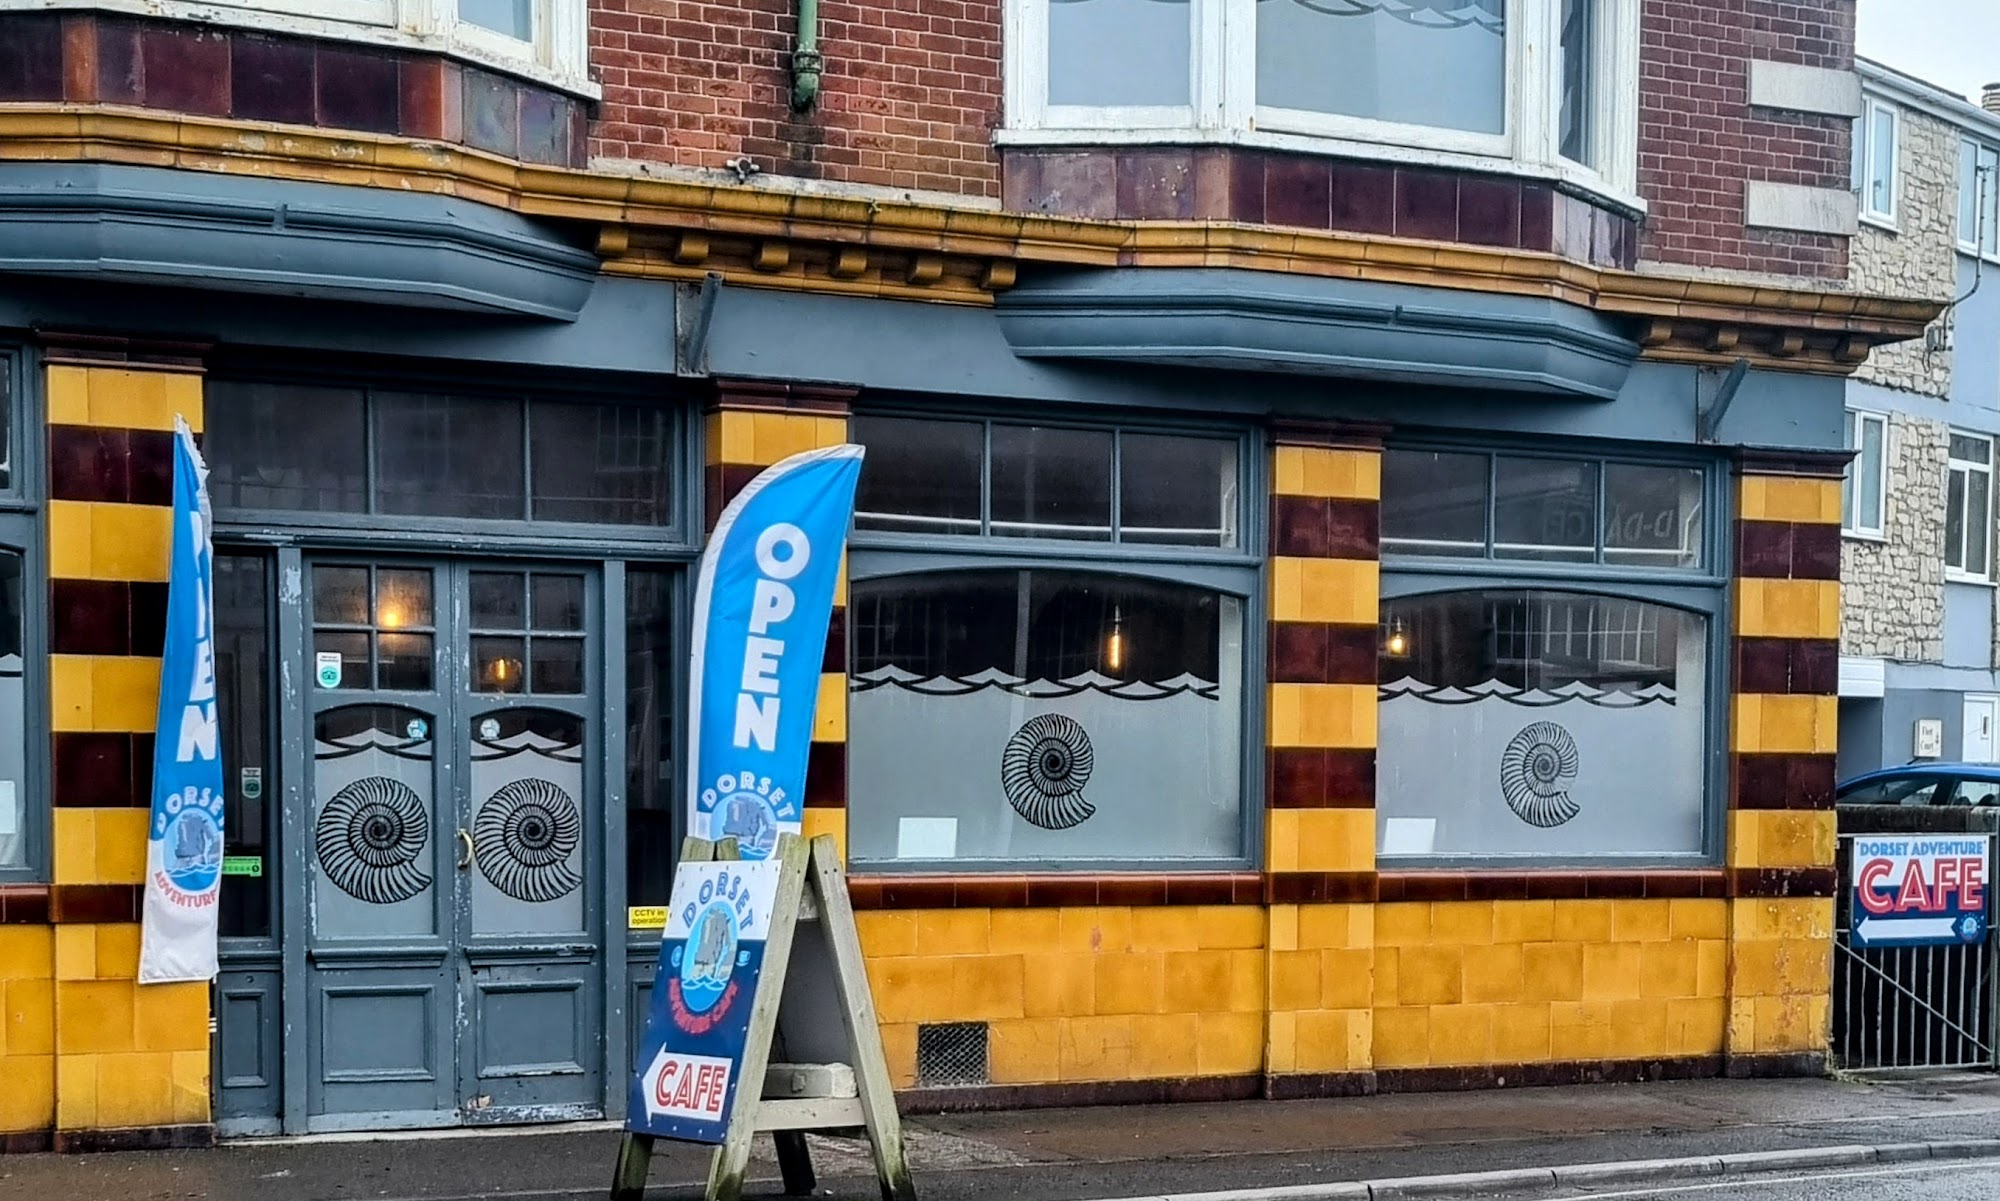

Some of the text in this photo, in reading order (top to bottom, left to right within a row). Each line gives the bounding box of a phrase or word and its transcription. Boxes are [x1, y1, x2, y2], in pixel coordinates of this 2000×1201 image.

[733, 522, 811, 752] OPEN
[702, 770, 797, 819] DORSET
[1859, 840, 1983, 856] DORSET ADVENTURE
[681, 871, 754, 931] DORSET
[1858, 857, 1984, 914] CAFE
[634, 908, 665, 917] CCTV in
[655, 1060, 726, 1113] CAFE
